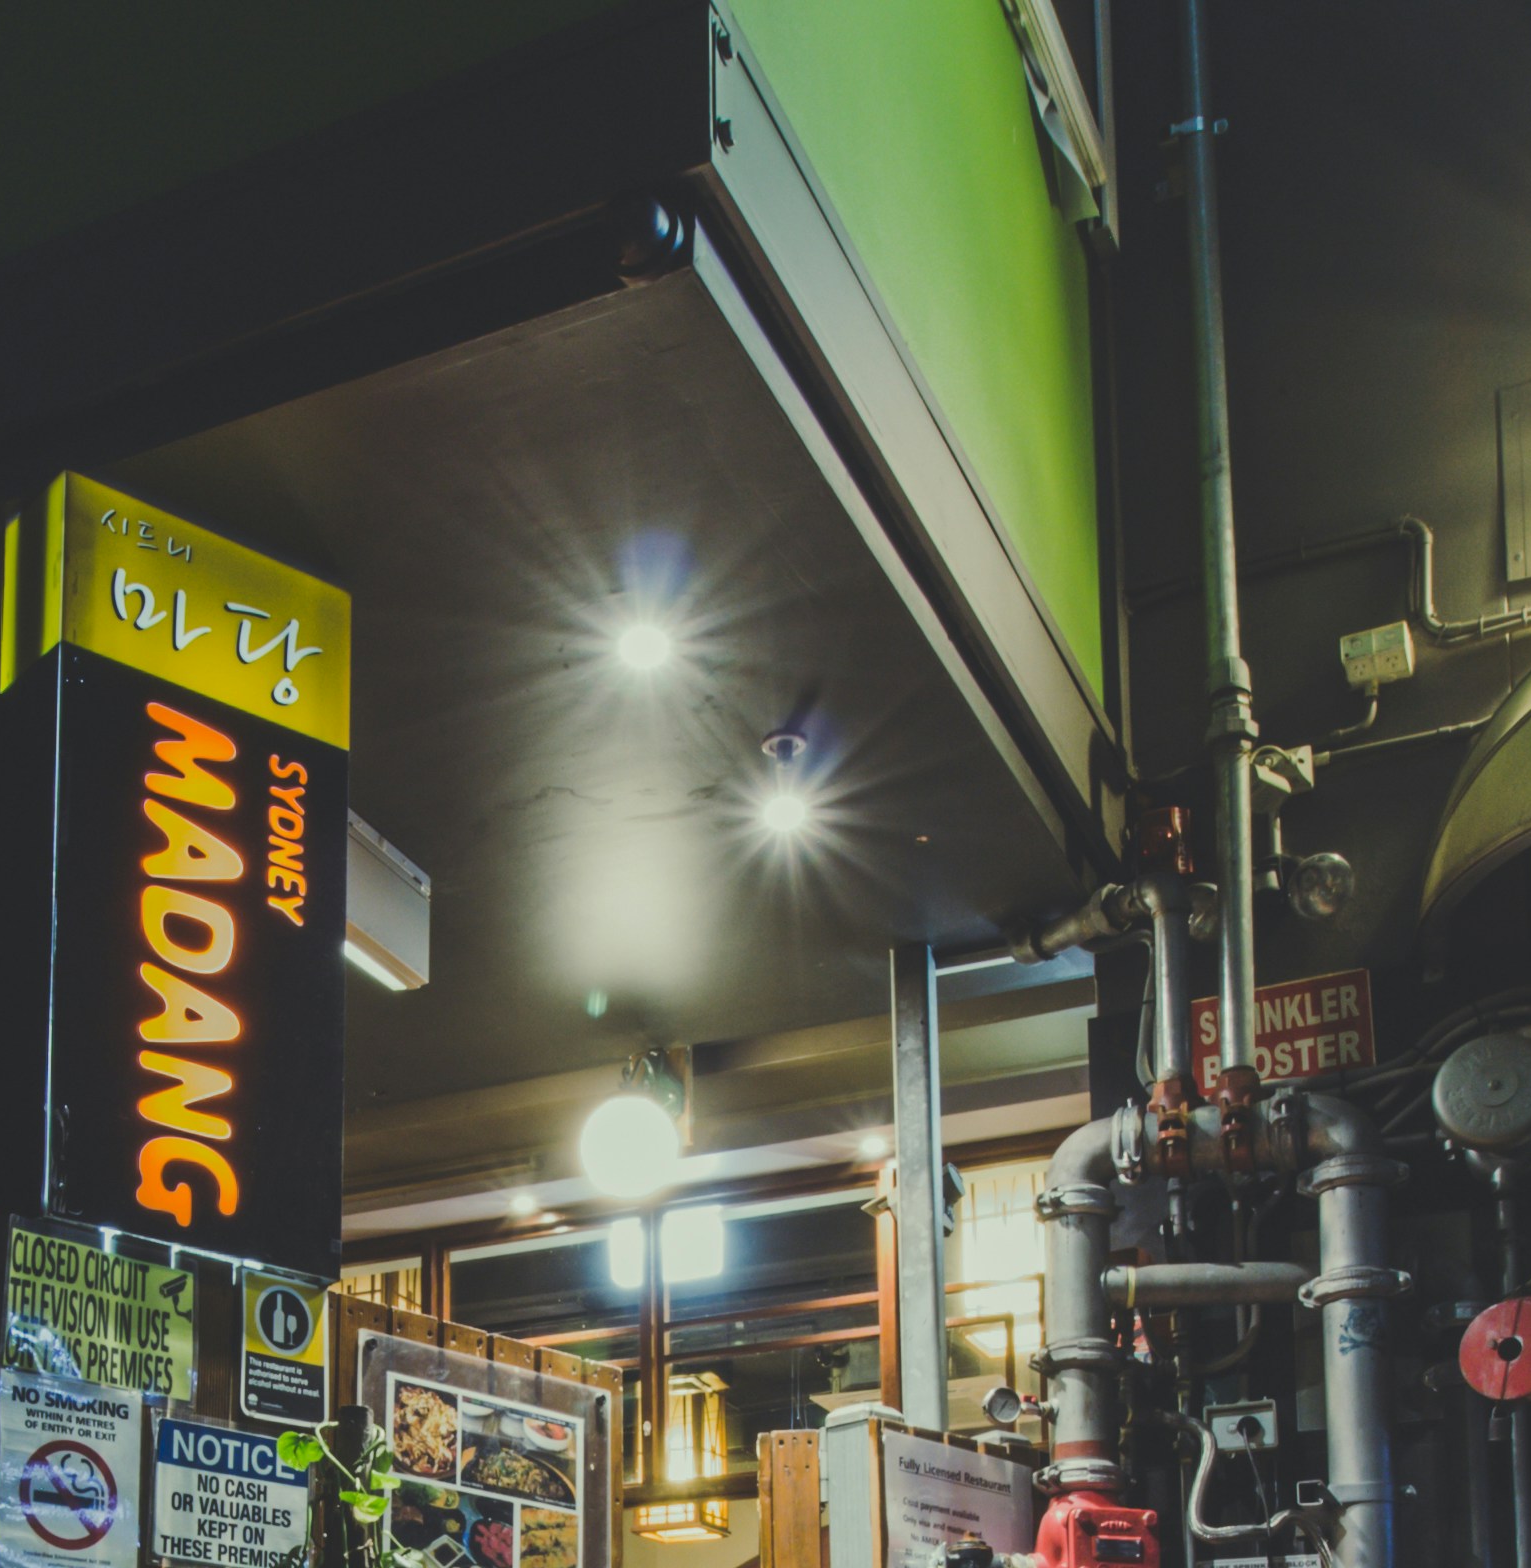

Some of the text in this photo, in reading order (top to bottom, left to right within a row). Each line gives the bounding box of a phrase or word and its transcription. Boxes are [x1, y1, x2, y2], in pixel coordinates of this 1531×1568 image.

[101, 509, 191, 563] 시드니
[112, 567, 323, 706] 마당
[267, 753, 309, 928] SYDNEY
[135, 701, 244, 1229] MADANG
[1199, 984, 1361, 1046] SINKLER
[1202, 1029, 1363, 1090] BOSTER
[11, 1232, 150, 1302] CLOSED CIRCUIT
[10, 1276, 171, 1353] TELEVISION IN USE
[86, 1341, 173, 1395] PREMISES
[11, 1385, 129, 1419] NO SMOKING
[26, 1407, 64, 1422] WITHIN
[75, 1416, 115, 1430] METRES
[25, 1419, 117, 1442] OF ENTRY OR EXIT
[172, 1428, 295, 1480] NOTICE
[197, 1473, 267, 1502] NO CASH
[899, 1456, 1012, 1493] Fully Licensed Restaurant
[171, 1492, 291, 1528] OR VALUABLES
[197, 1518, 265, 1546] KEPT ON
[160, 1534, 212, 1560] THESE
